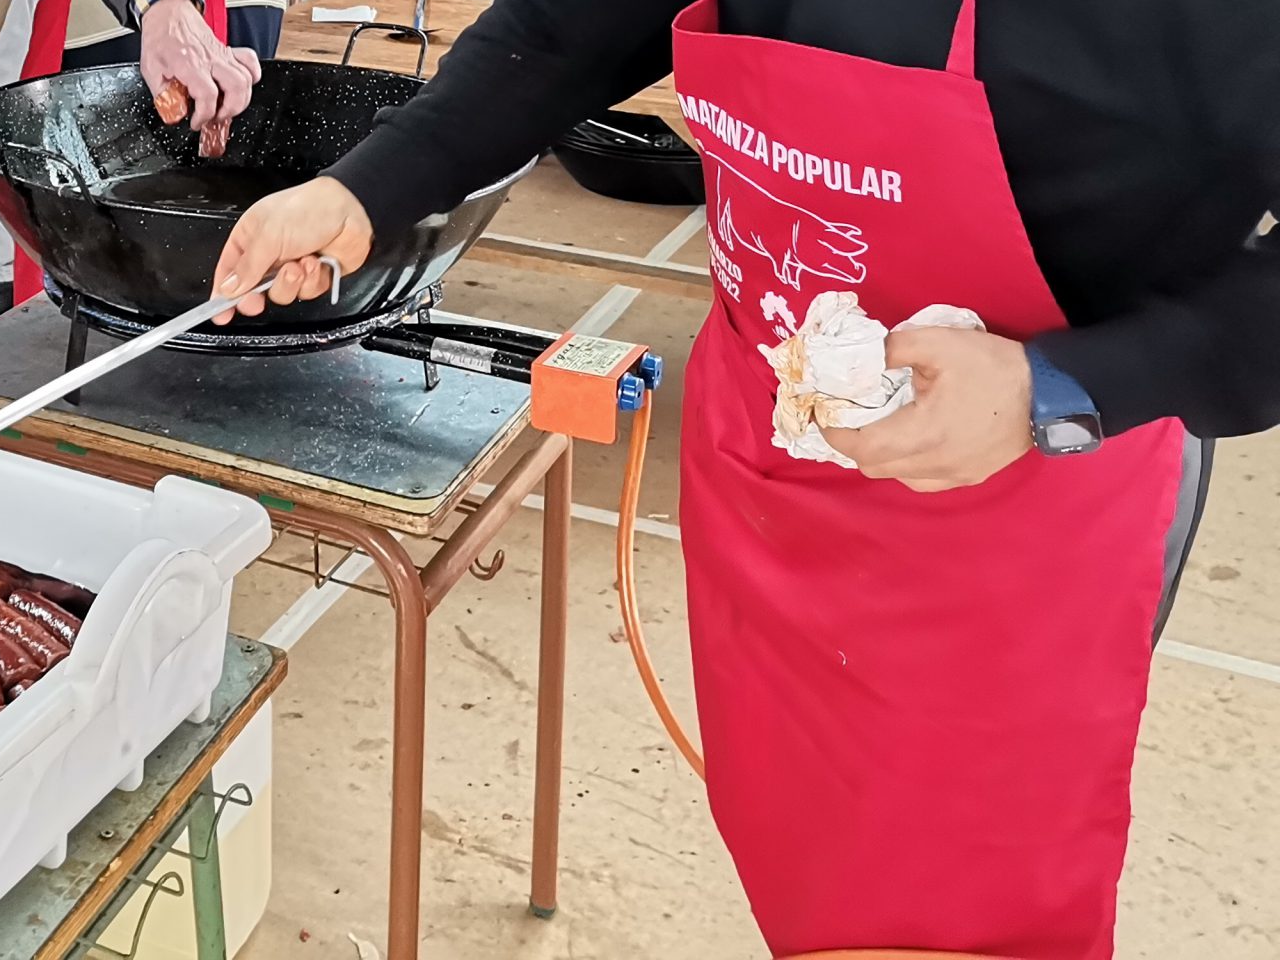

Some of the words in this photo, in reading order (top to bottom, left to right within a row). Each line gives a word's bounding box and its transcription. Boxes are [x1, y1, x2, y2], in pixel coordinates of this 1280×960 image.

[676, 92, 769, 167] MATANZA
[771, 141, 903, 203] POPULAR
[717, 262, 741, 303] 2022
